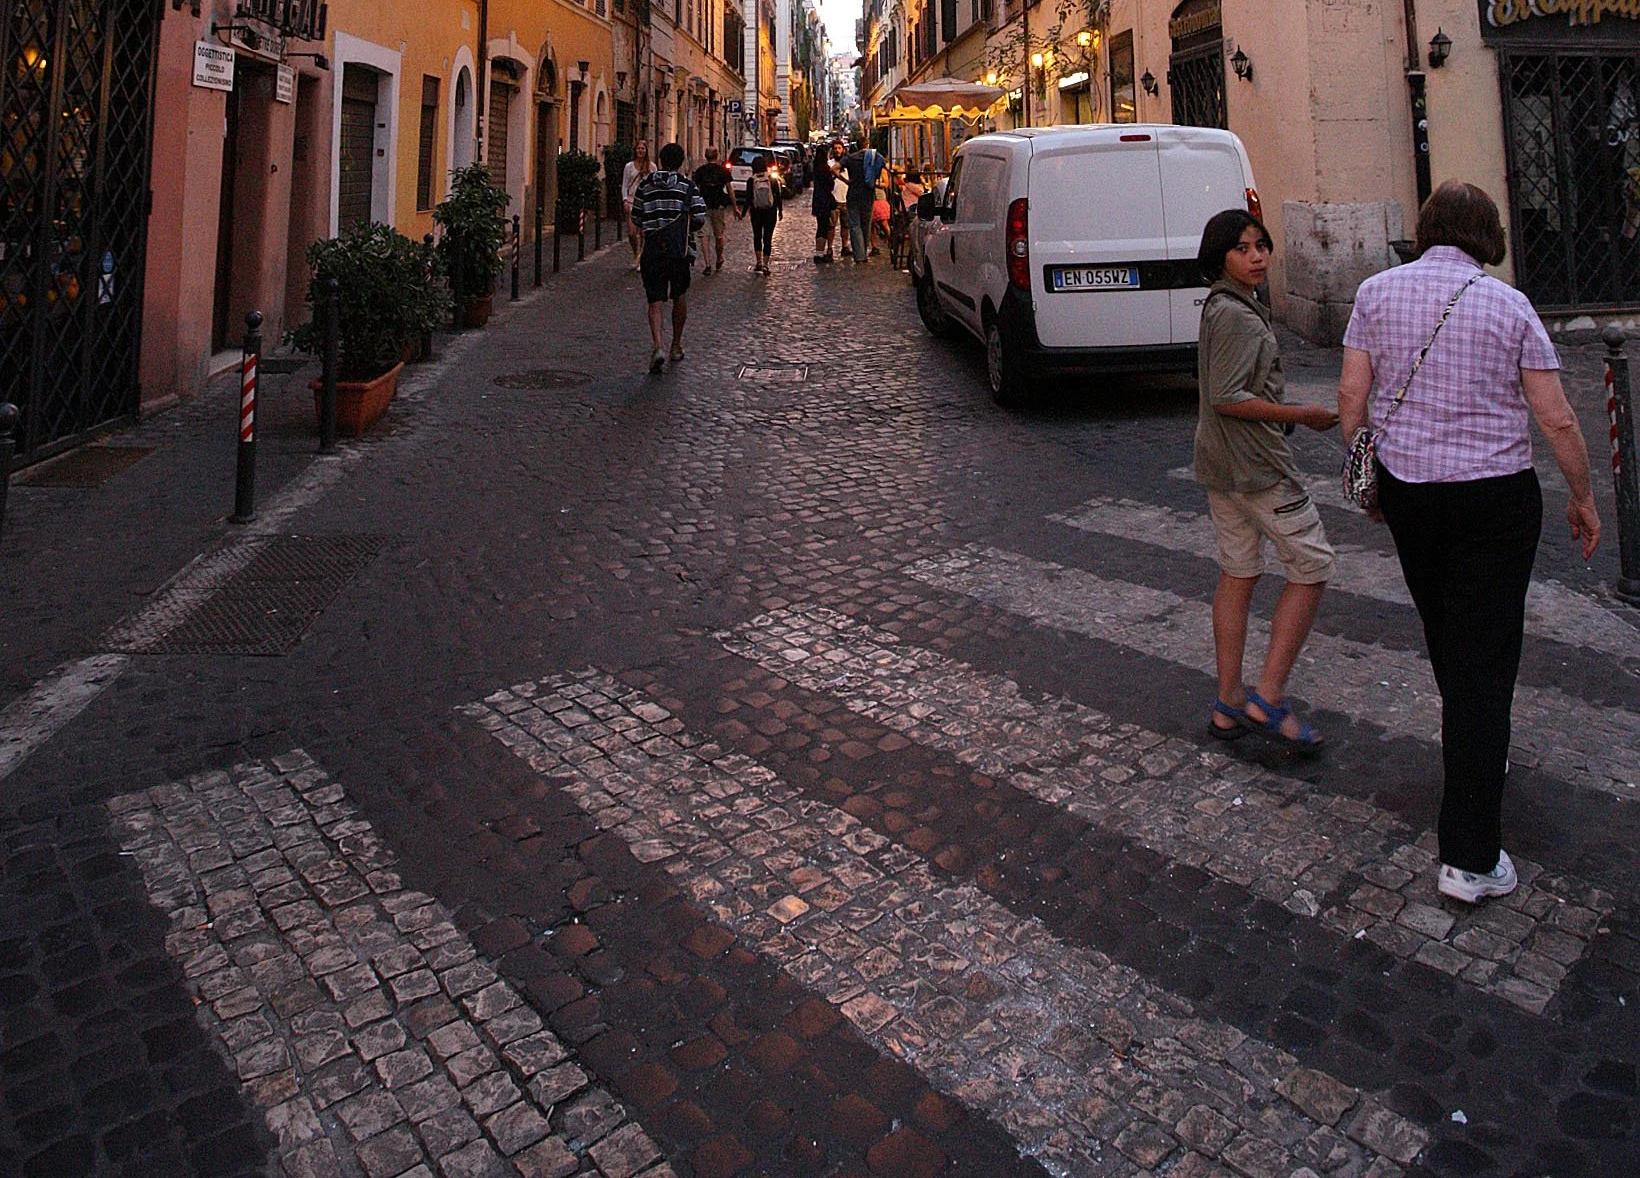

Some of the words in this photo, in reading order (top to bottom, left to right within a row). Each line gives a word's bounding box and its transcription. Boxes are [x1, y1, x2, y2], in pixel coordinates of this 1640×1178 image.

[198, 47, 232, 62] OGGETTISTICA
[206, 63, 224, 74] PICCOLO
[196, 74, 232, 87] COLLEZIONISMO
[732, 102, 739, 111] P
[1065, 272, 1081, 285] EN
[1087, 270, 1128, 284] 055WZ
